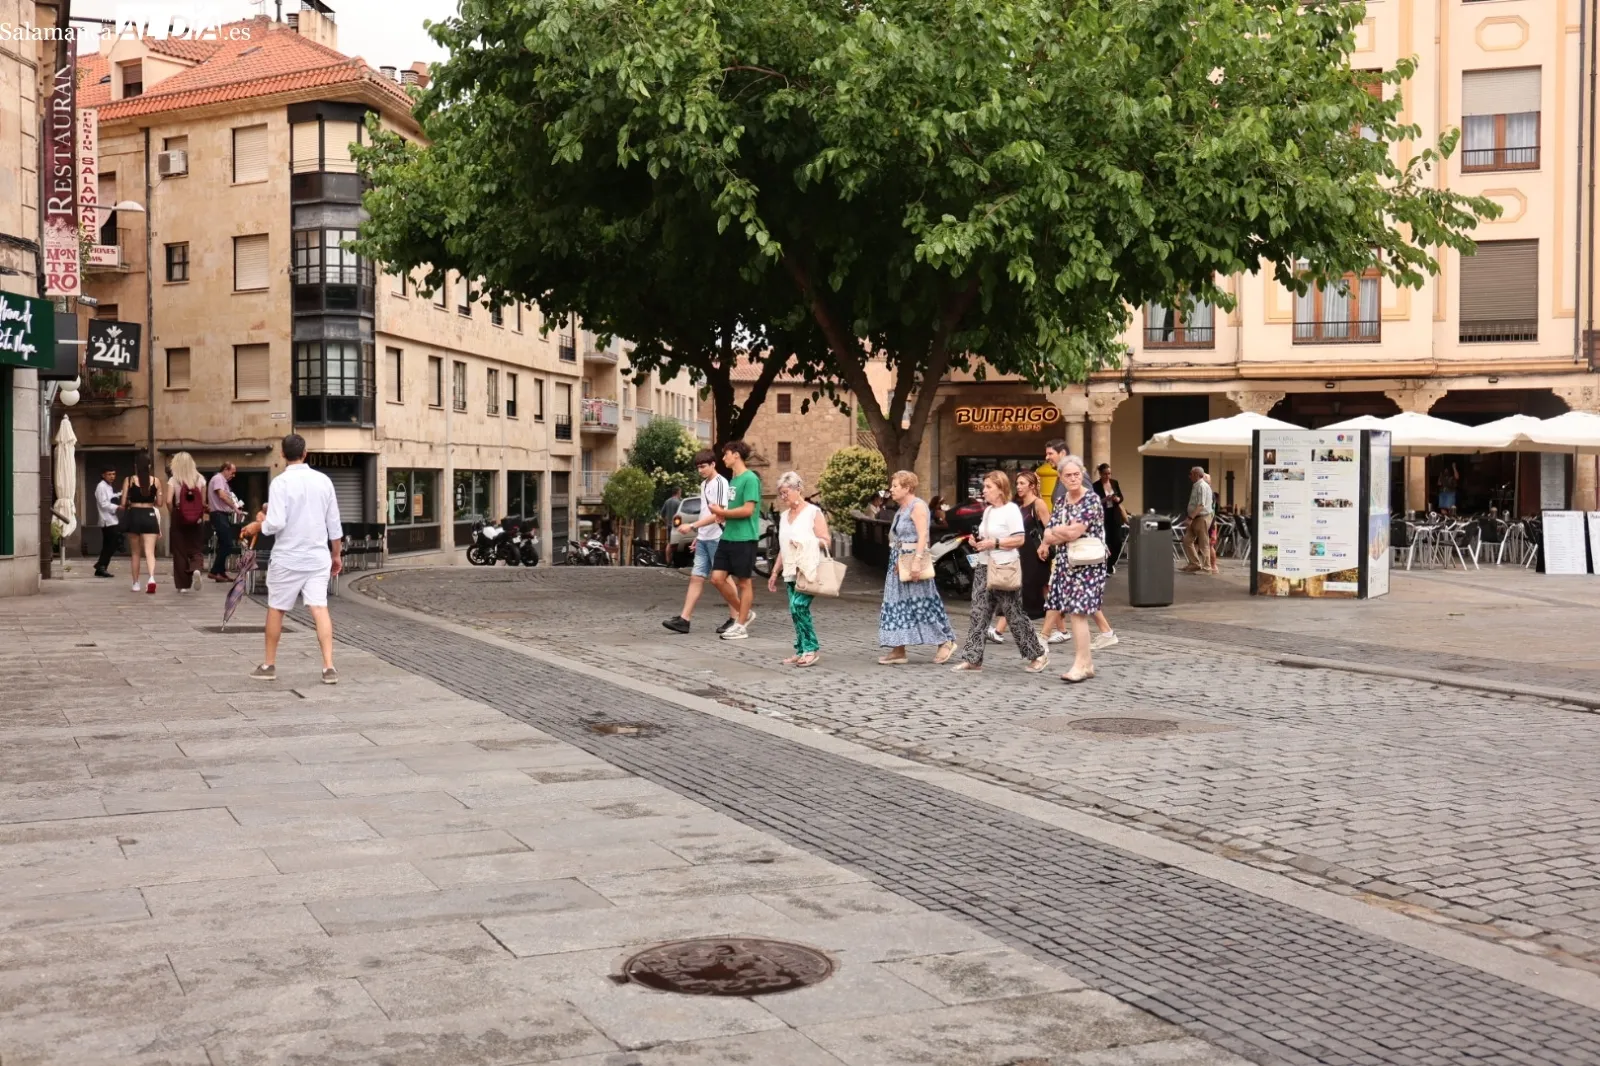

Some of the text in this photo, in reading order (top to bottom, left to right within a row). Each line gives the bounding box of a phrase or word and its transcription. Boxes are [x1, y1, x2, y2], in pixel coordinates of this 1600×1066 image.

[80, 157, 97, 242] SALAMANCA
[91, 335, 136, 346] CAJERO
[92, 342, 131, 366] 24h
[955, 406, 1060, 424] BUITRAGO
